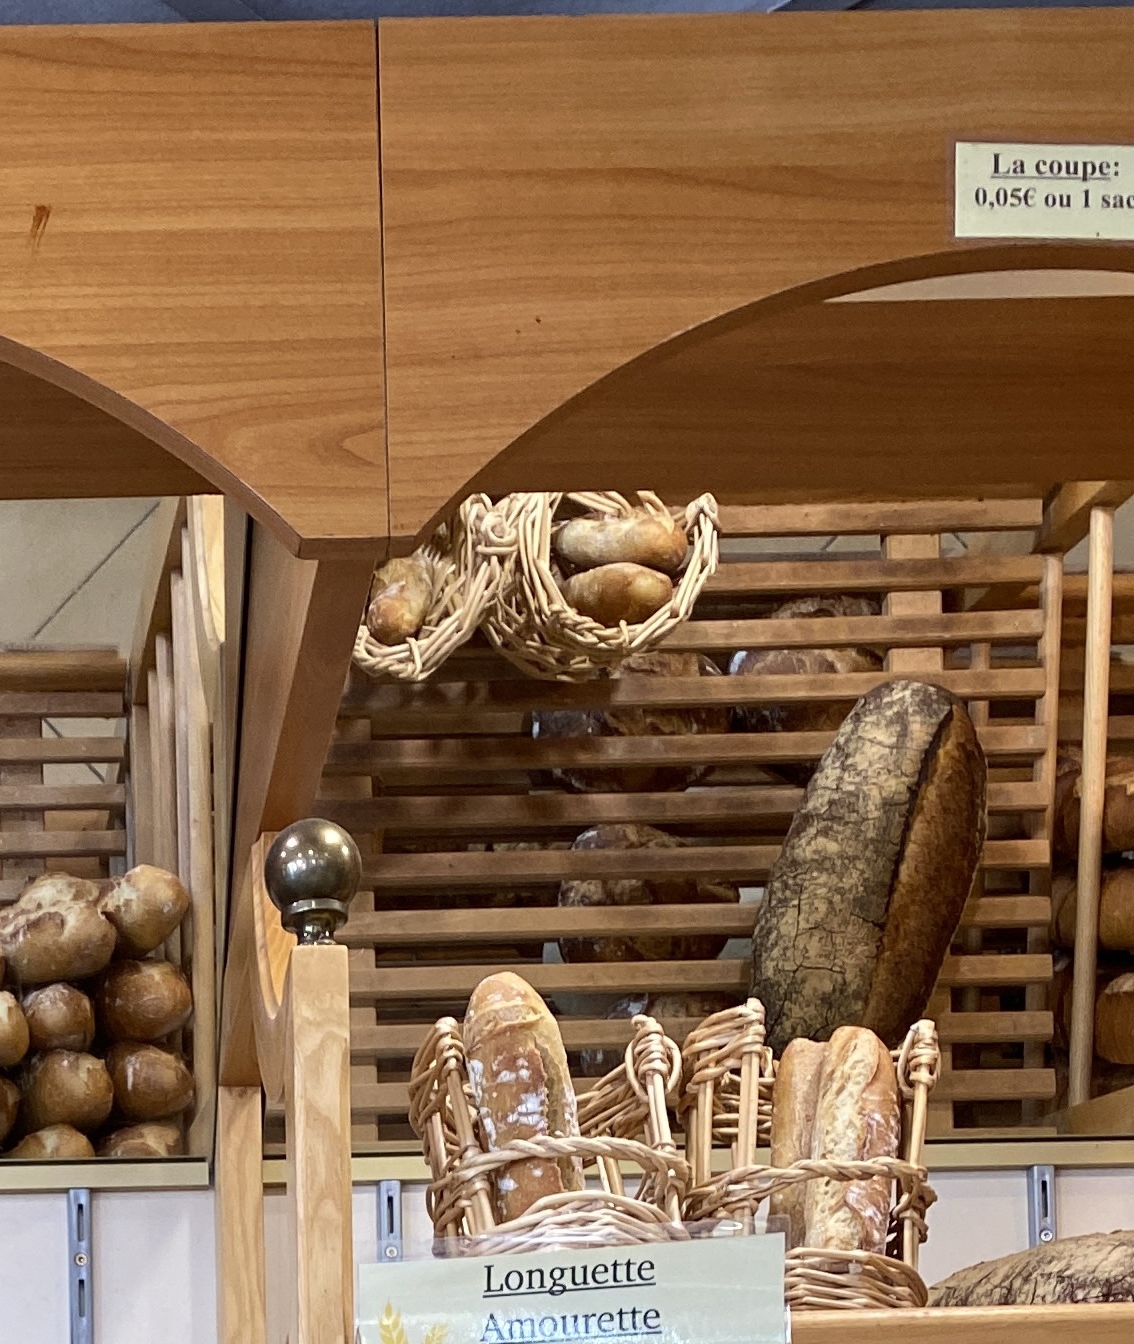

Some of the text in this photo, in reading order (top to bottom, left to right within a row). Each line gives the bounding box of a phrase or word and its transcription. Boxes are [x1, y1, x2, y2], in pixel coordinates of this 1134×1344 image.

[993, 153, 1119, 182] La coupe:
[975, 187, 1037, 210] 0,05€
[1044, 194, 1071, 208] ou
[1083, 189, 1090, 208] 1
[483, 1257, 656, 1297] Longuette
[479, 1306, 661, 1344] Amourette
